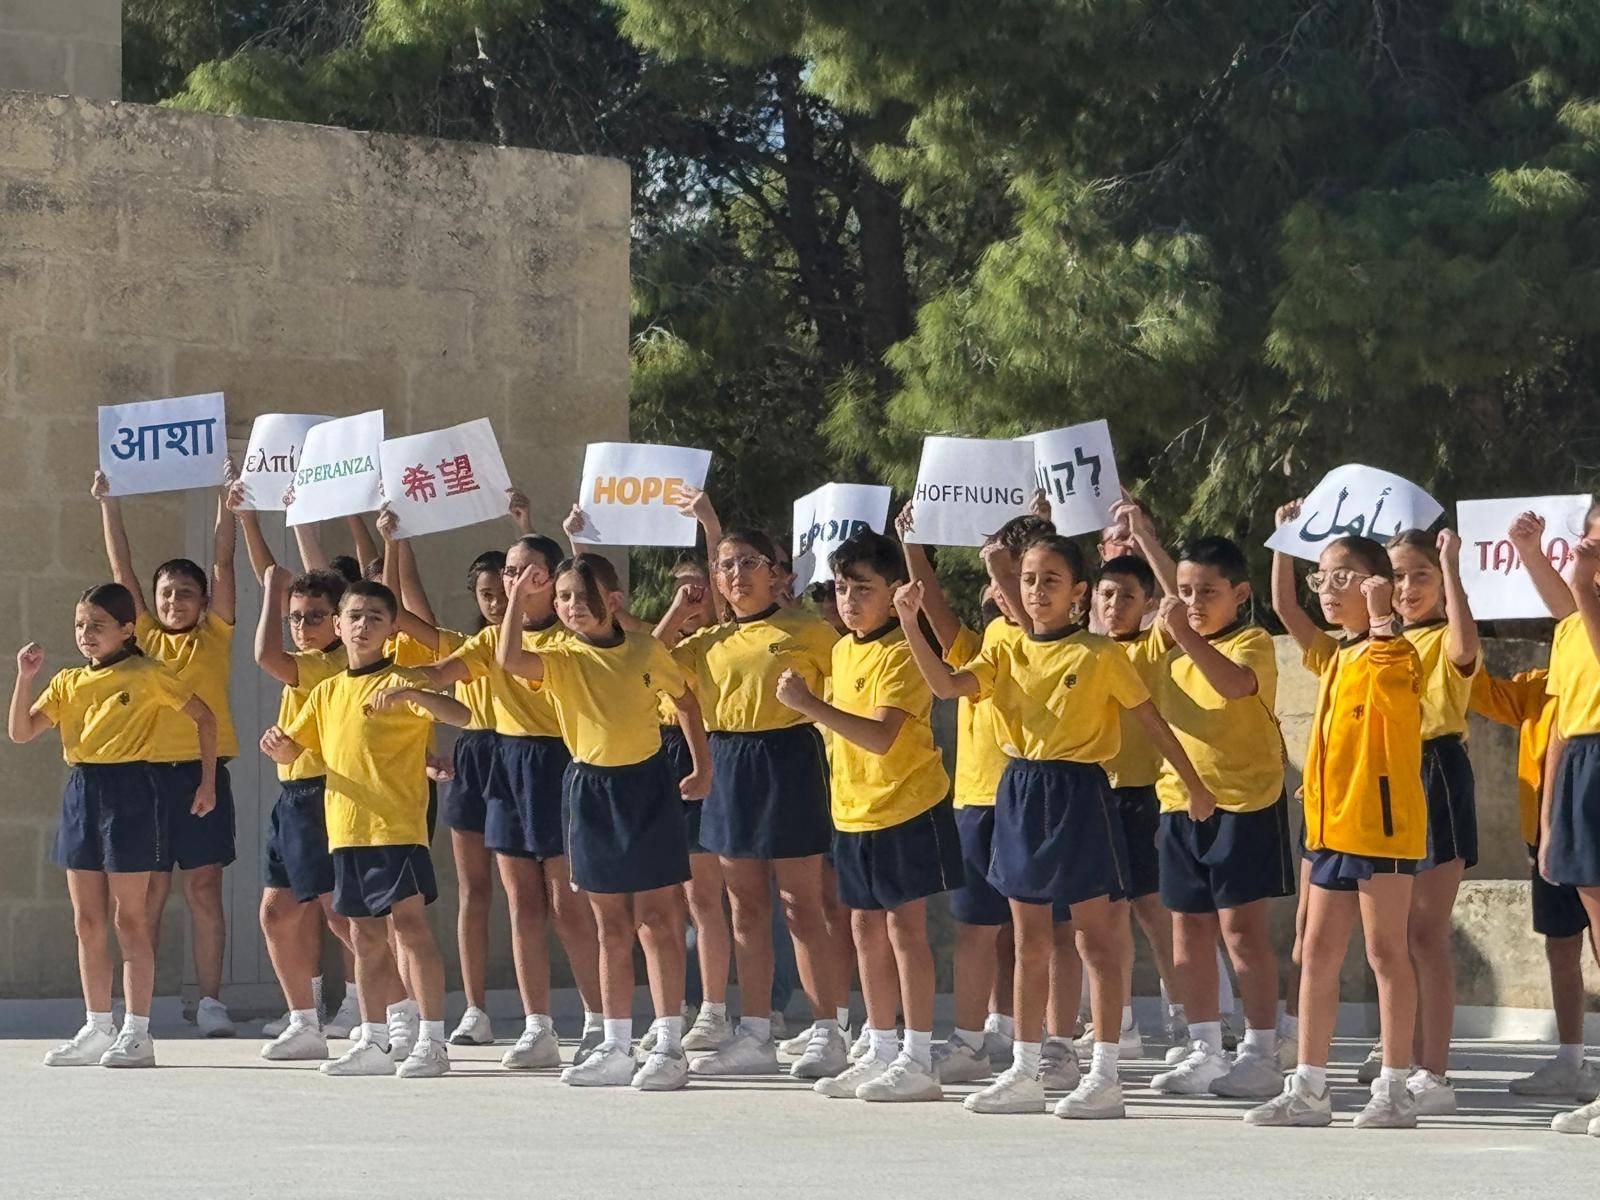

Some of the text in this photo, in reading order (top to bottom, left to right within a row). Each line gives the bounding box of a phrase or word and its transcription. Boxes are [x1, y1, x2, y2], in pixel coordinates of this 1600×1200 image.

[110, 417, 217, 461] आशा
[246, 445, 302, 473] ελπί
[297, 455, 375, 486] SPERANZA
[401, 454, 481, 503] 希望
[593, 476, 684, 505] HOPE
[916, 483, 1025, 505] HOFFNUNG
[1473, 537, 1570, 575] TAA
